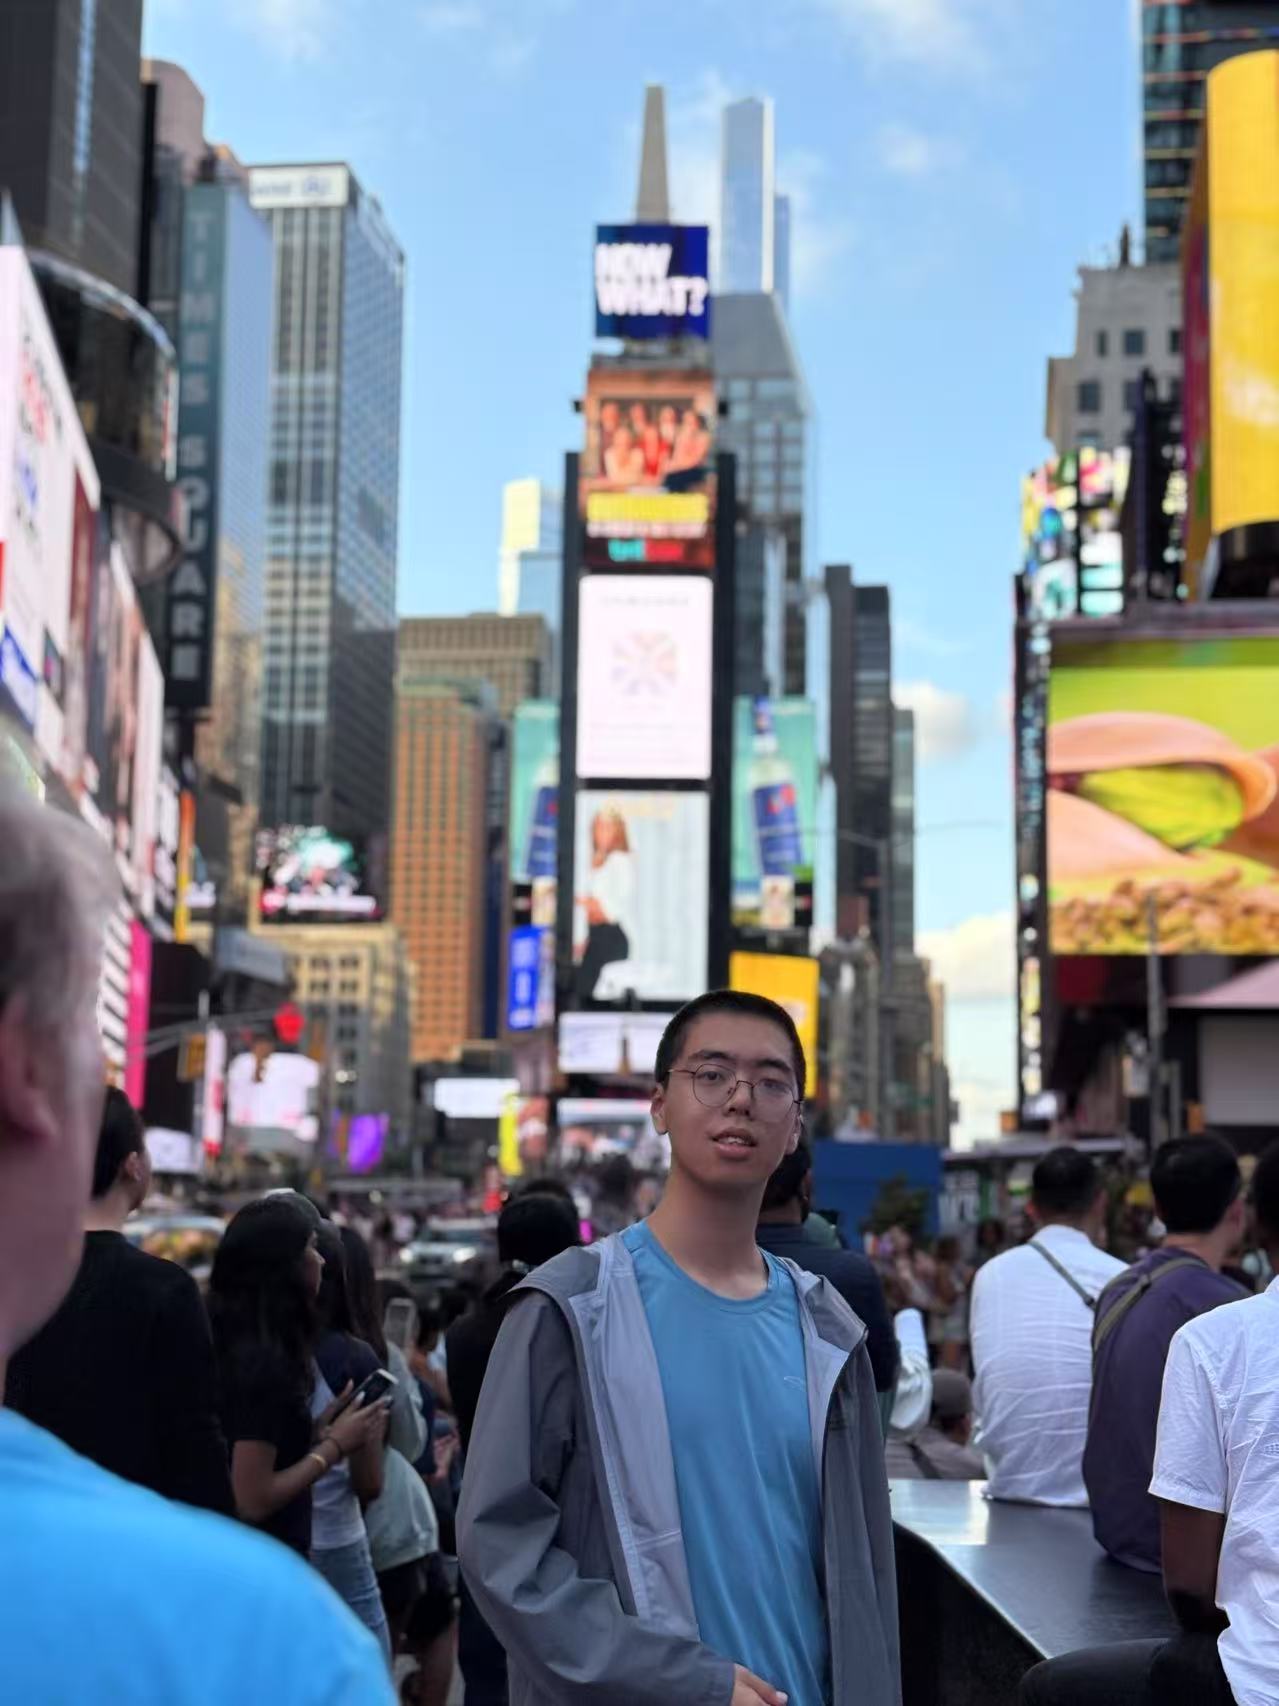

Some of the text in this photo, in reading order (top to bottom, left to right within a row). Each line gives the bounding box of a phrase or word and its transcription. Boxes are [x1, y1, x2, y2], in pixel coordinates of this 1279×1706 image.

[597, 276, 708, 316] WHAT?
[171, 211, 216, 681] TIMES SQUARE
